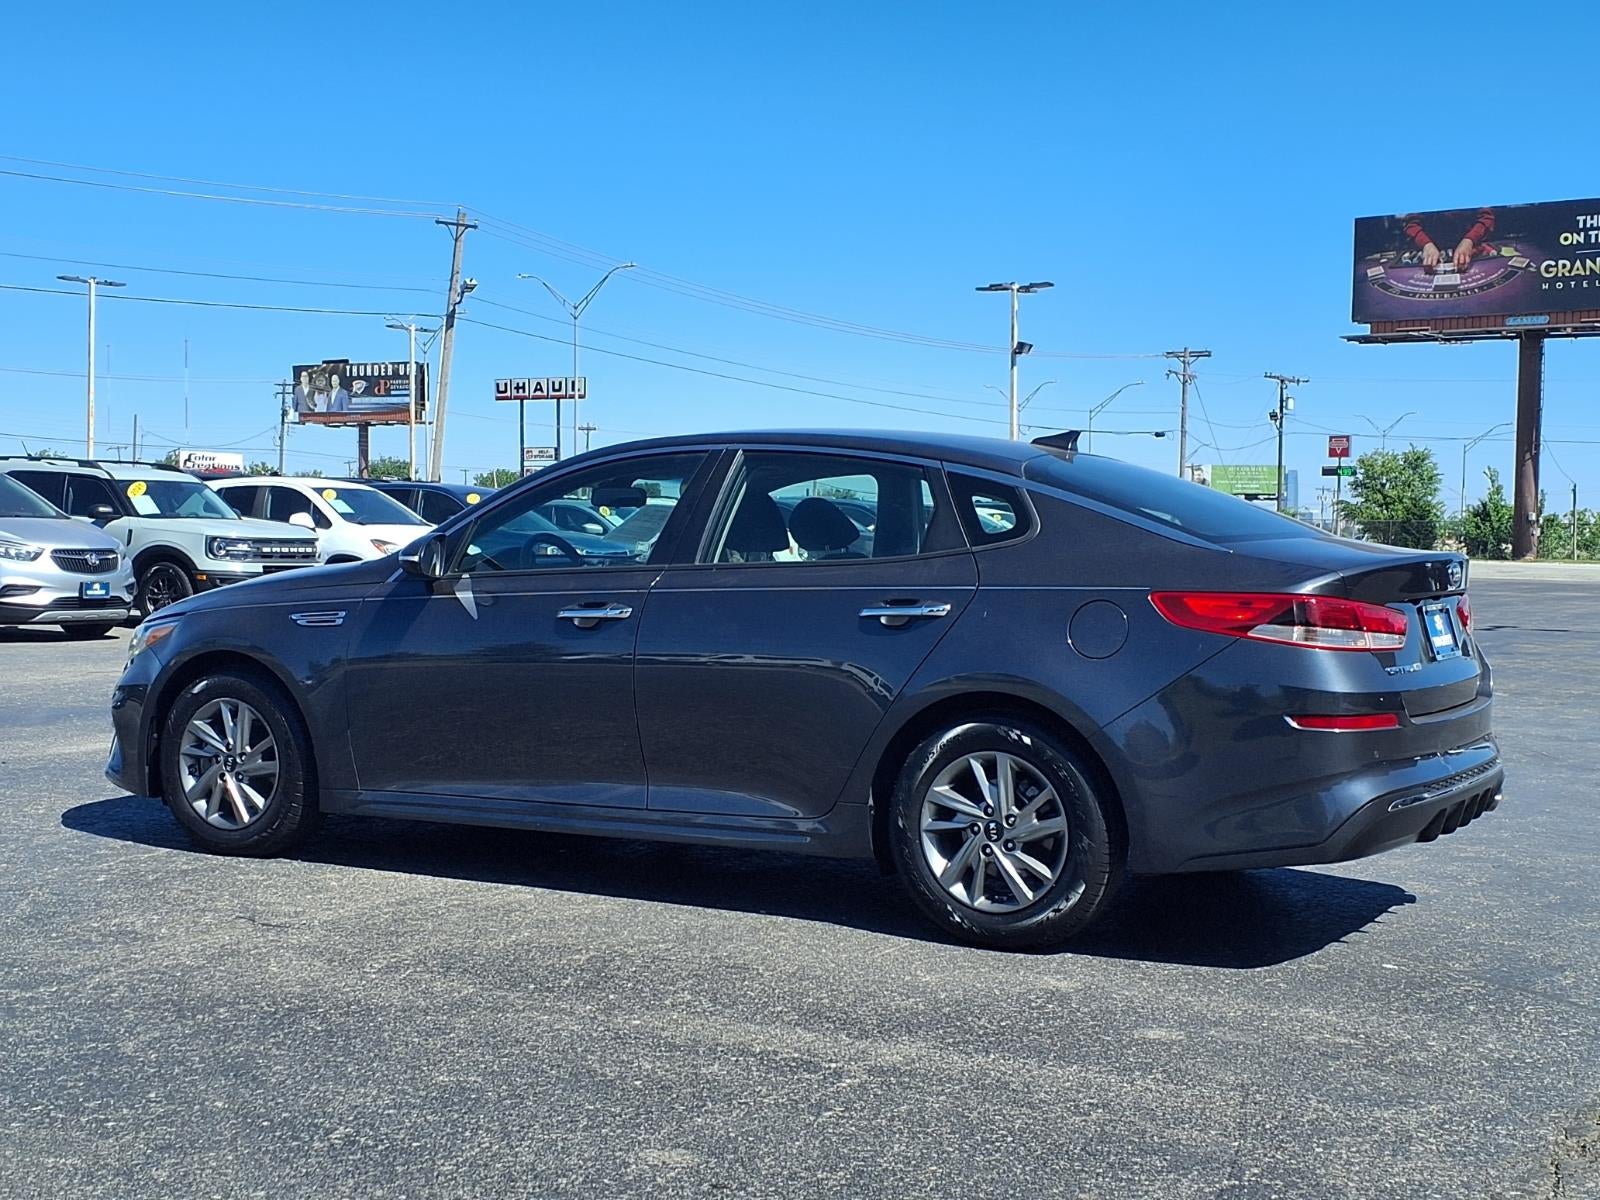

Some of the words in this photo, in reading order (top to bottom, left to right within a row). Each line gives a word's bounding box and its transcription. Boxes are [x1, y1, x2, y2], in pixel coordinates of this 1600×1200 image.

[1576, 214, 1600, 229] TH
[1559, 231, 1585, 246] ON
[1588, 230, 1600, 244] T
[1540, 256, 1600, 278] GRAN
[1542, 279, 1600, 290] HOTEL
[345, 363, 393, 377] THUNDER
[989, 822, 998, 840] KIA
